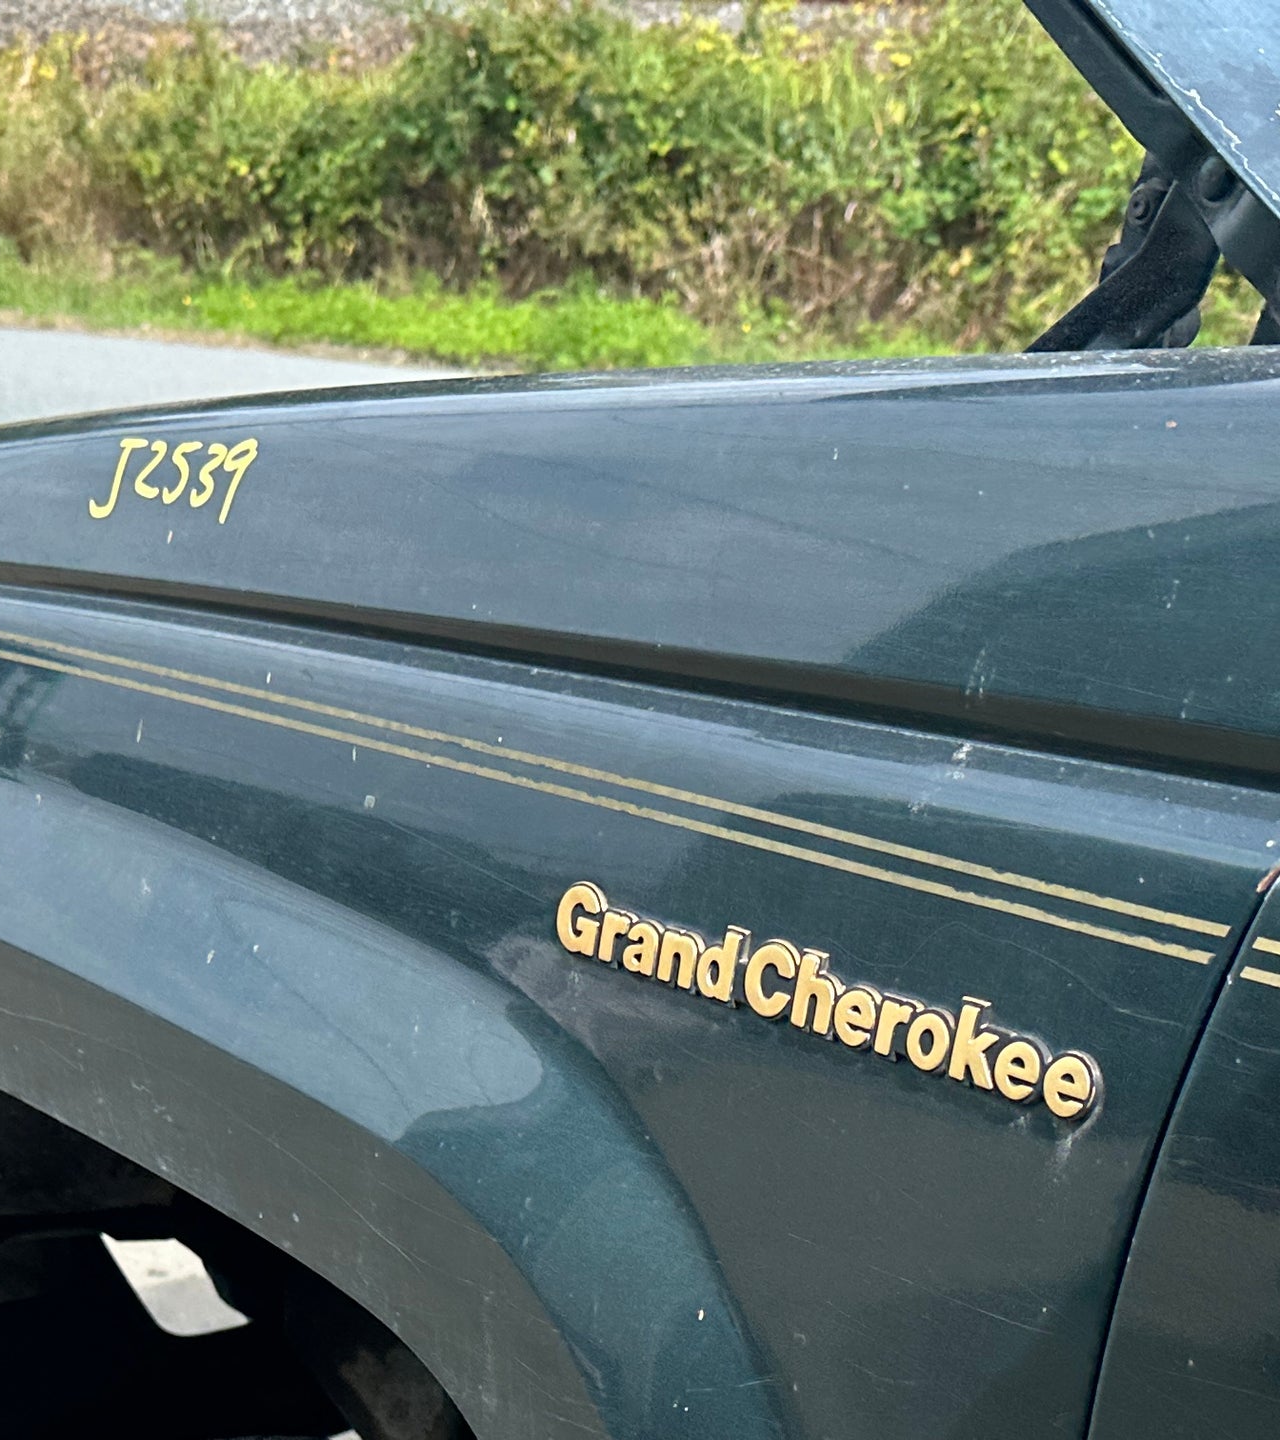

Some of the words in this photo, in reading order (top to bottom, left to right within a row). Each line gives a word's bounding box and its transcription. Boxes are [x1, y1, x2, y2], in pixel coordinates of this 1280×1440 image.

[88, 437, 259, 525] J2539
[555, 880, 751, 1008] Grand
[743, 938, 1103, 1120] Cherokee
